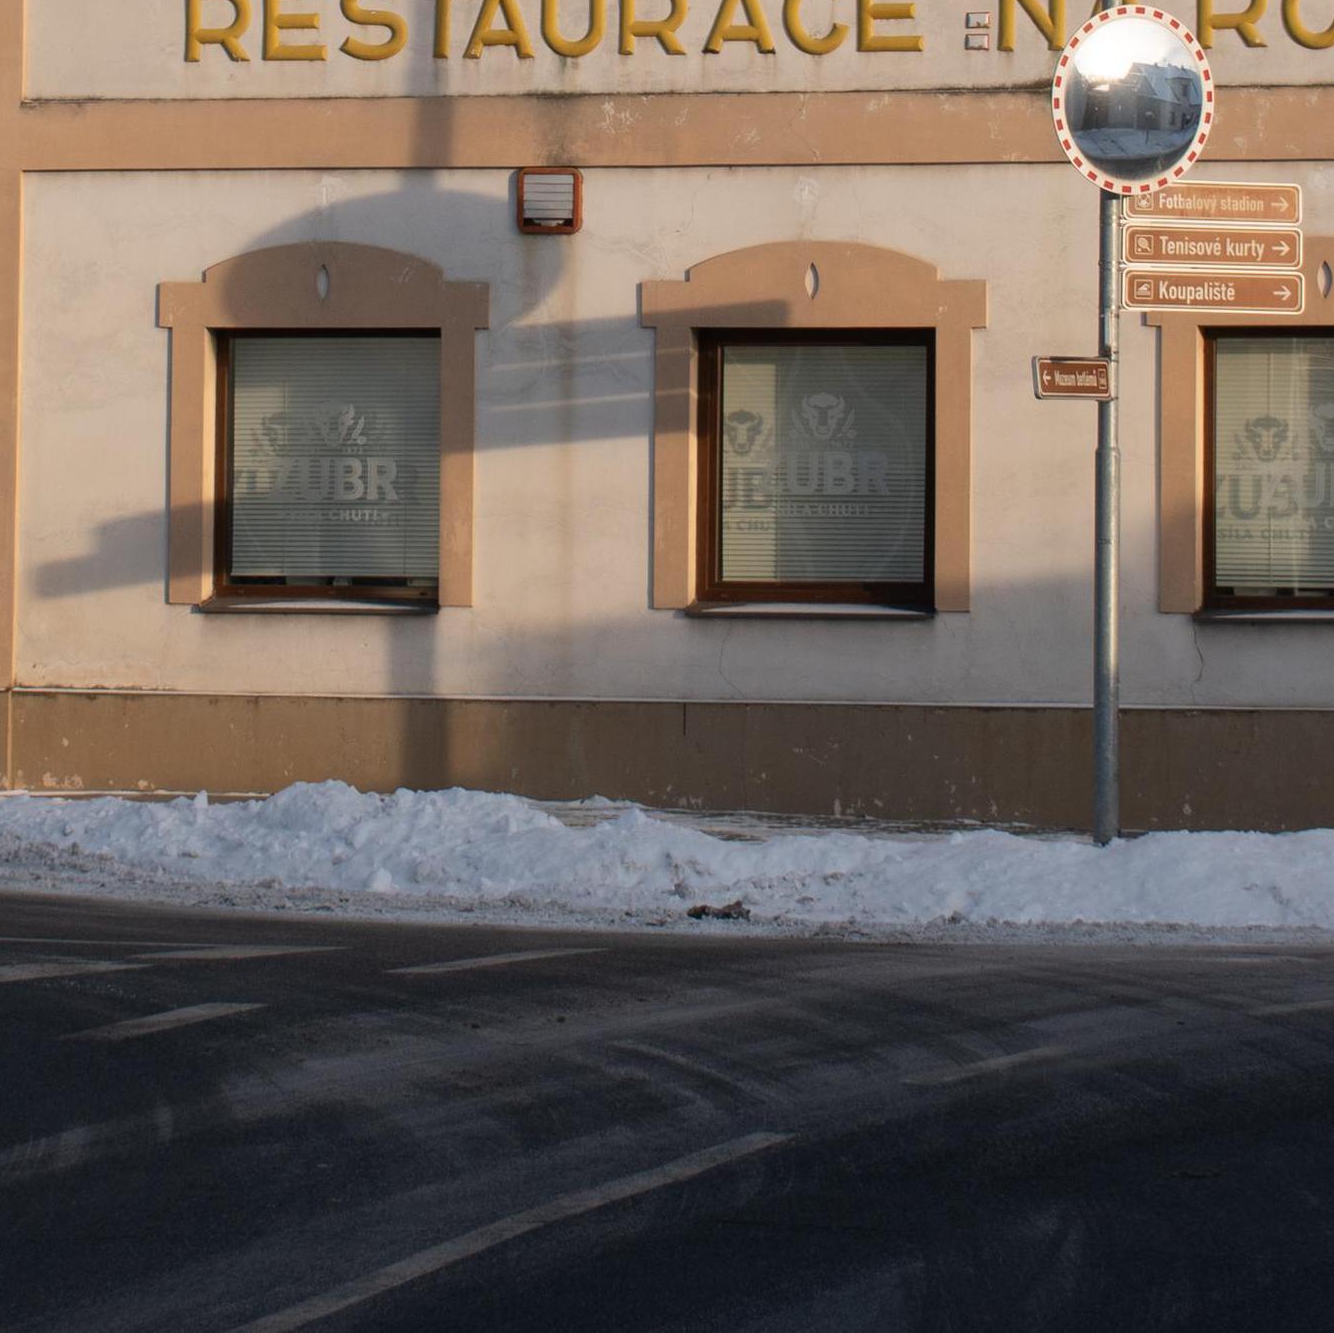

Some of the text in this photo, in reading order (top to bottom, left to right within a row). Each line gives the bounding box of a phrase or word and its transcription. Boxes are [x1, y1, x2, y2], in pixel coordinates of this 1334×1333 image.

[1158, 193, 1264, 213] Fotbalový stadion
[1158, 235, 1265, 261] Tenisové kurty
[1158, 280, 1235, 304] Koupaliště
